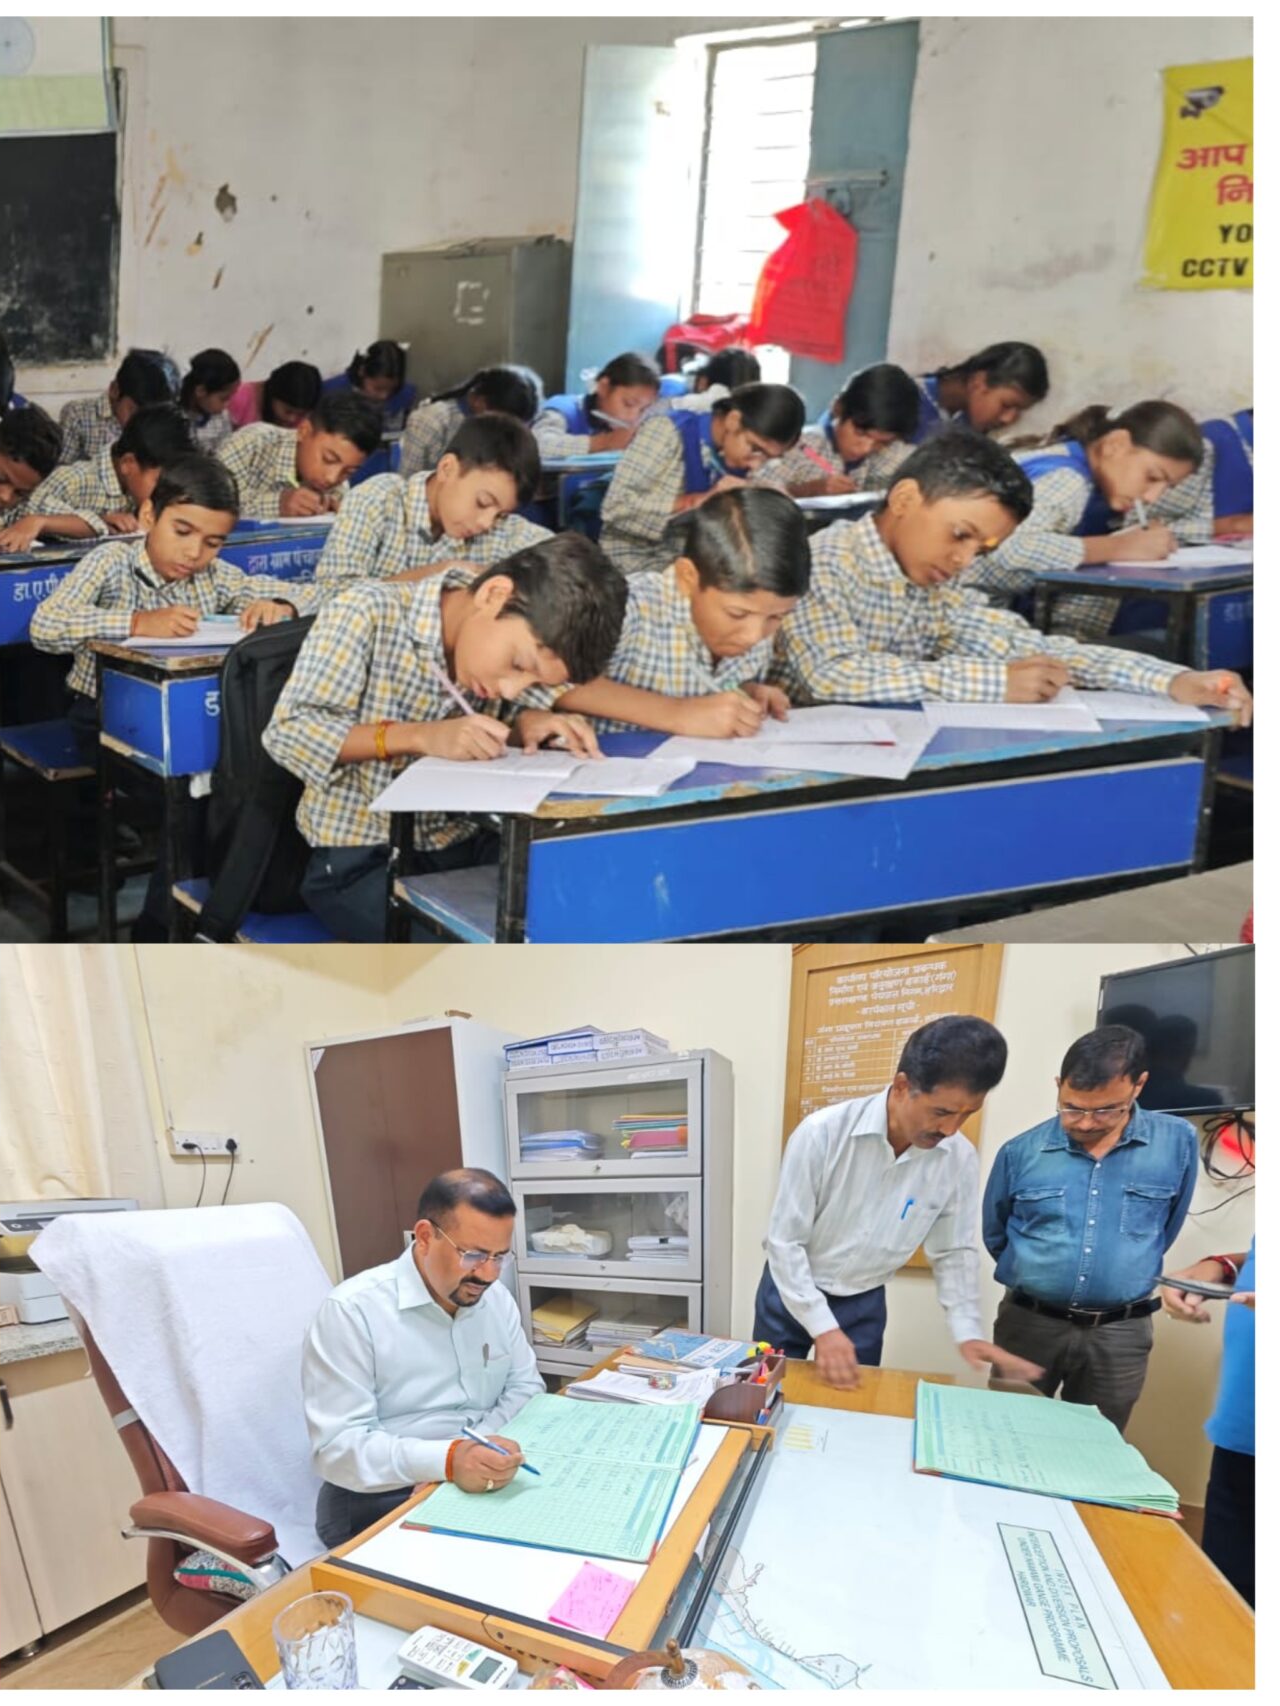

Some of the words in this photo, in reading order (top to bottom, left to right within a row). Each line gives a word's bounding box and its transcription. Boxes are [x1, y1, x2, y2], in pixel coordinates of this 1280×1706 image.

[1176, 143, 1248, 170] आप
[1216, 173, 1253, 205] नि
[1219, 222, 1253, 244] YO
[1180, 257, 1249, 278] CCTV
[1043, 1573, 1057, 1588] AND
[1048, 1587, 1071, 1627] DIVERSION
[1055, 1568, 1074, 1597] INDEX
[1068, 1602, 1088, 1630] PLAN
[1042, 1608, 1071, 1664] PROGRAMME
[1063, 1627, 1094, 1682] PROPOSALS
